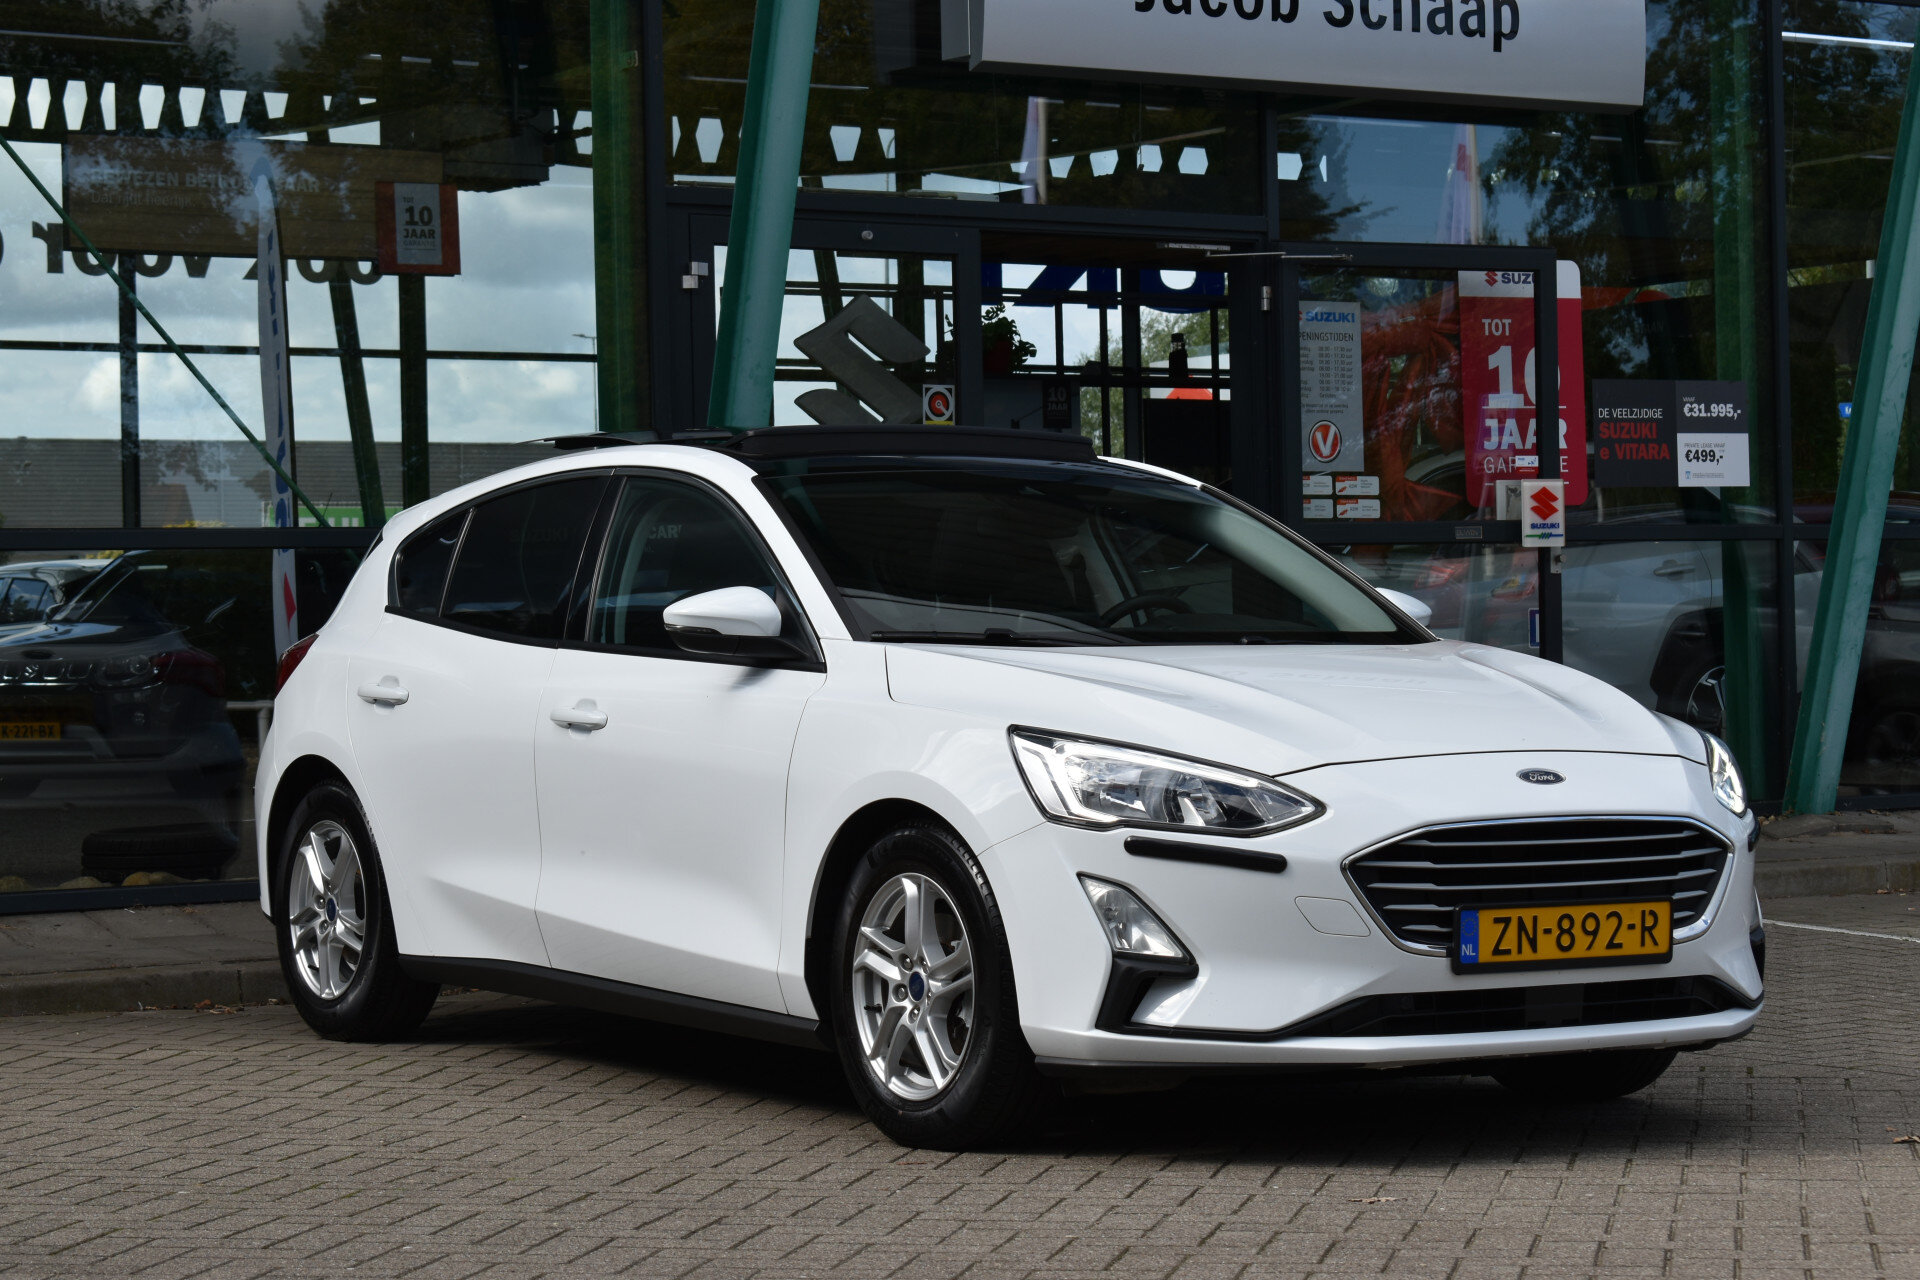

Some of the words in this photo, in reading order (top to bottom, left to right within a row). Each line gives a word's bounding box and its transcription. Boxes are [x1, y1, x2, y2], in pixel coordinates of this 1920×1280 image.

[405, 205, 434, 226] 10
[403, 229, 436, 239] JAAR
[1305, 311, 1355, 323] SUZUKI
[1482, 318, 1512, 336] TOT
[1048, 386, 1067, 402] 10
[1598, 408, 1610, 419] DE
[1612, 408, 1663, 419] VEELZIJDIGE
[1683, 403, 1741, 420] €31.995,-
[1599, 421, 1658, 440] SUZUKI
[1600, 447, 1610, 460] e
[1614, 442, 1671, 460] VITARA
[1685, 449, 1724, 466] €499,-
[1530, 522, 1560, 530] SUZUKI
[1529, 772, 1556, 781] Ford
[1491, 909, 1660, 957] ZN-892-R
[1461, 943, 1477, 957] NL
